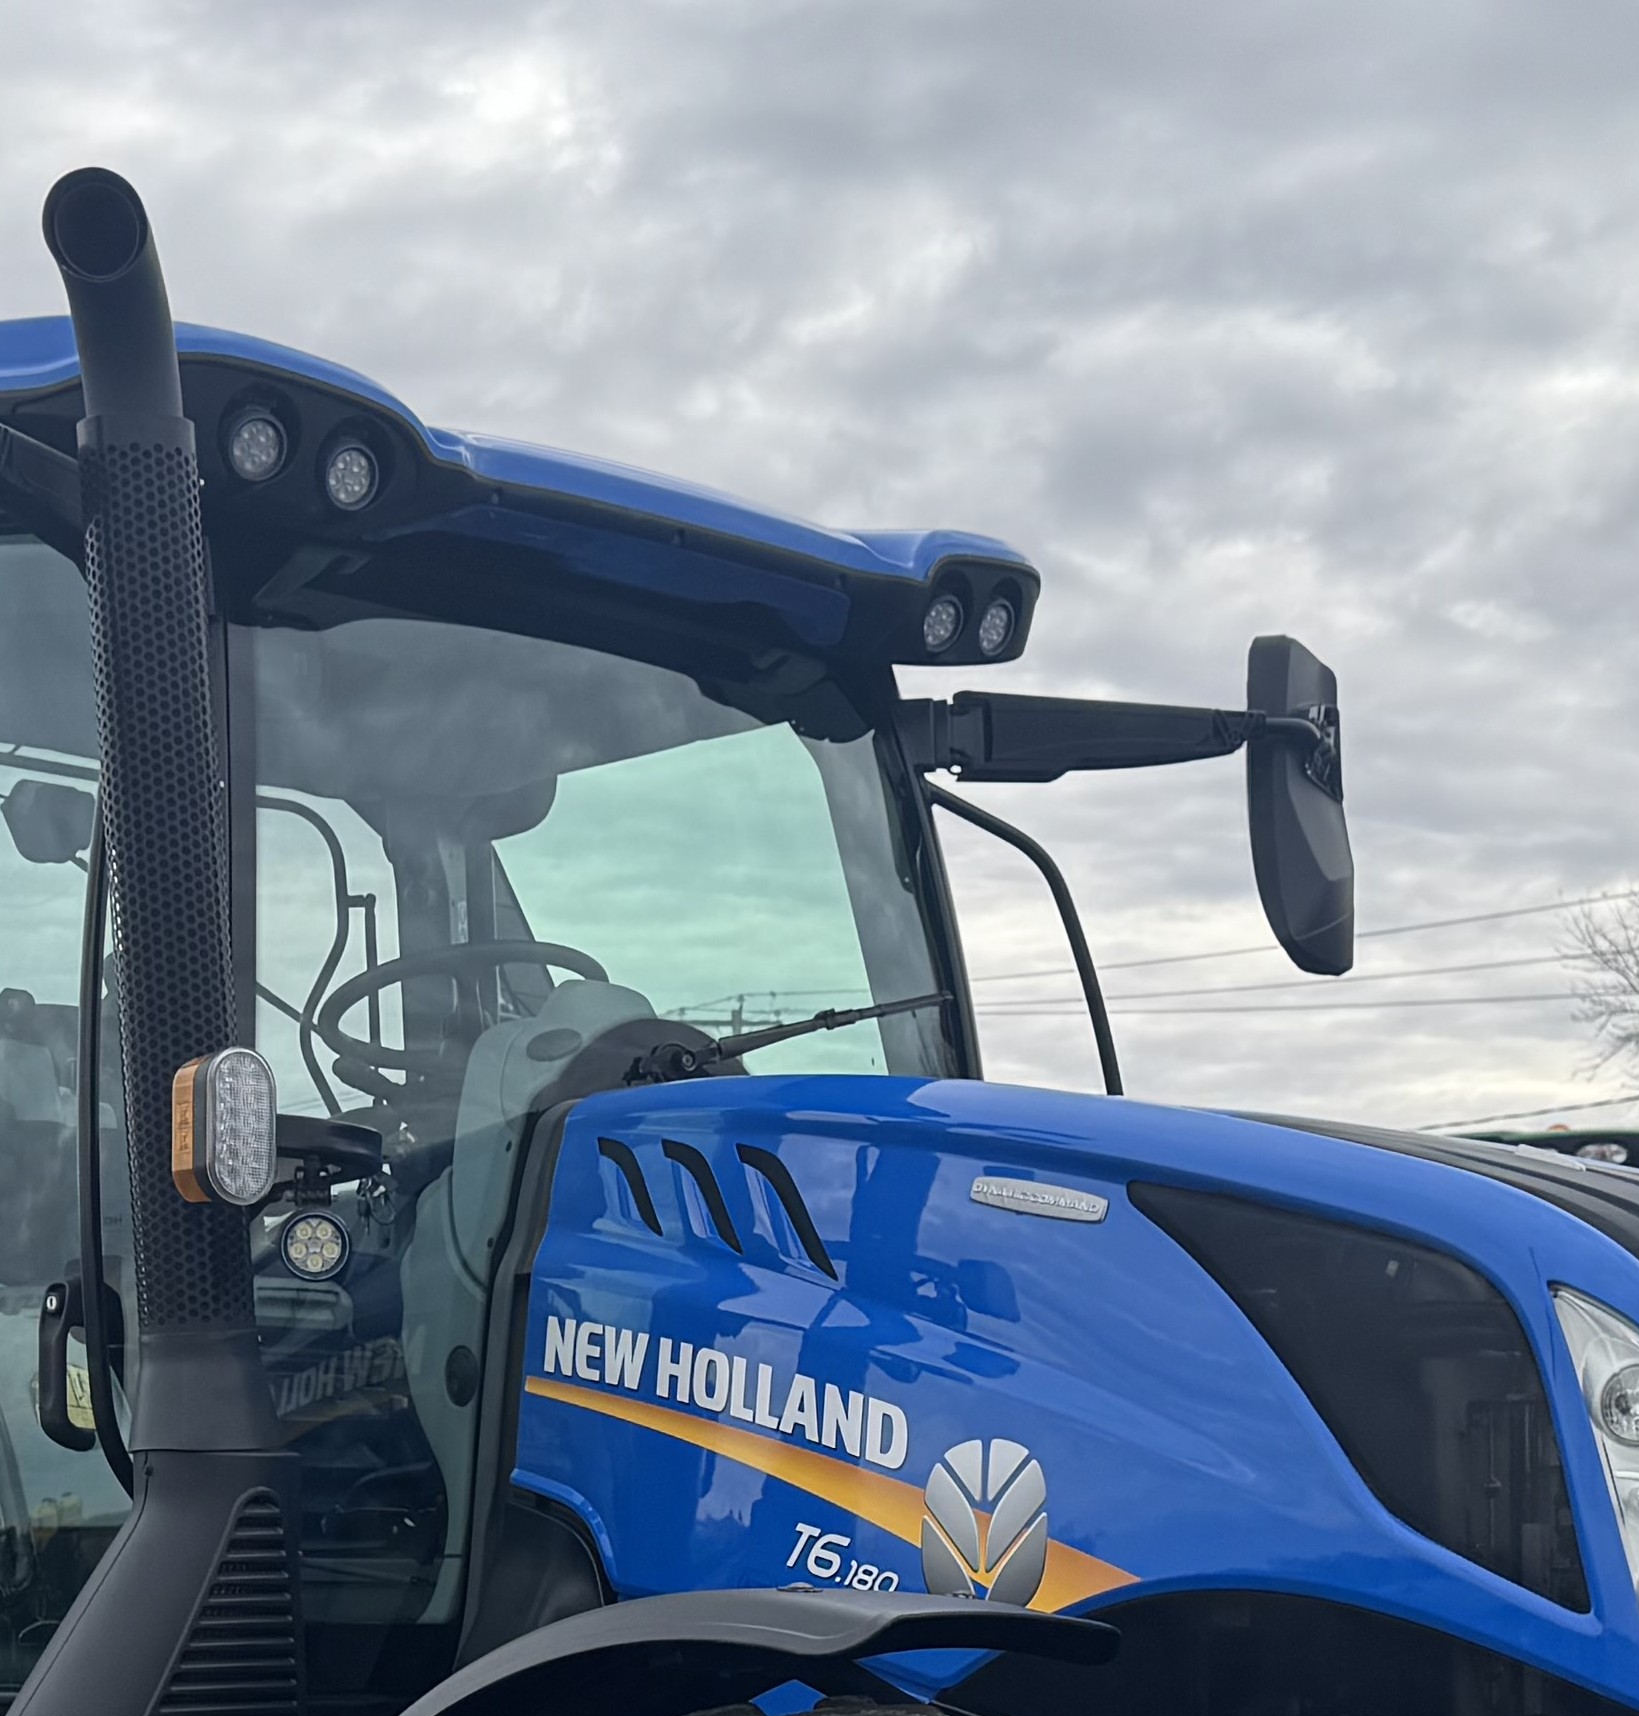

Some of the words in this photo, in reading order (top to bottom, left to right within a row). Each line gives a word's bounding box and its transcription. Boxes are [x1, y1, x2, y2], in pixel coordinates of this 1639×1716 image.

[543, 1316, 649, 1390] NEW
[656, 1337, 908, 1470] HOLLAND
[786, 1522, 899, 1592] T6.180
